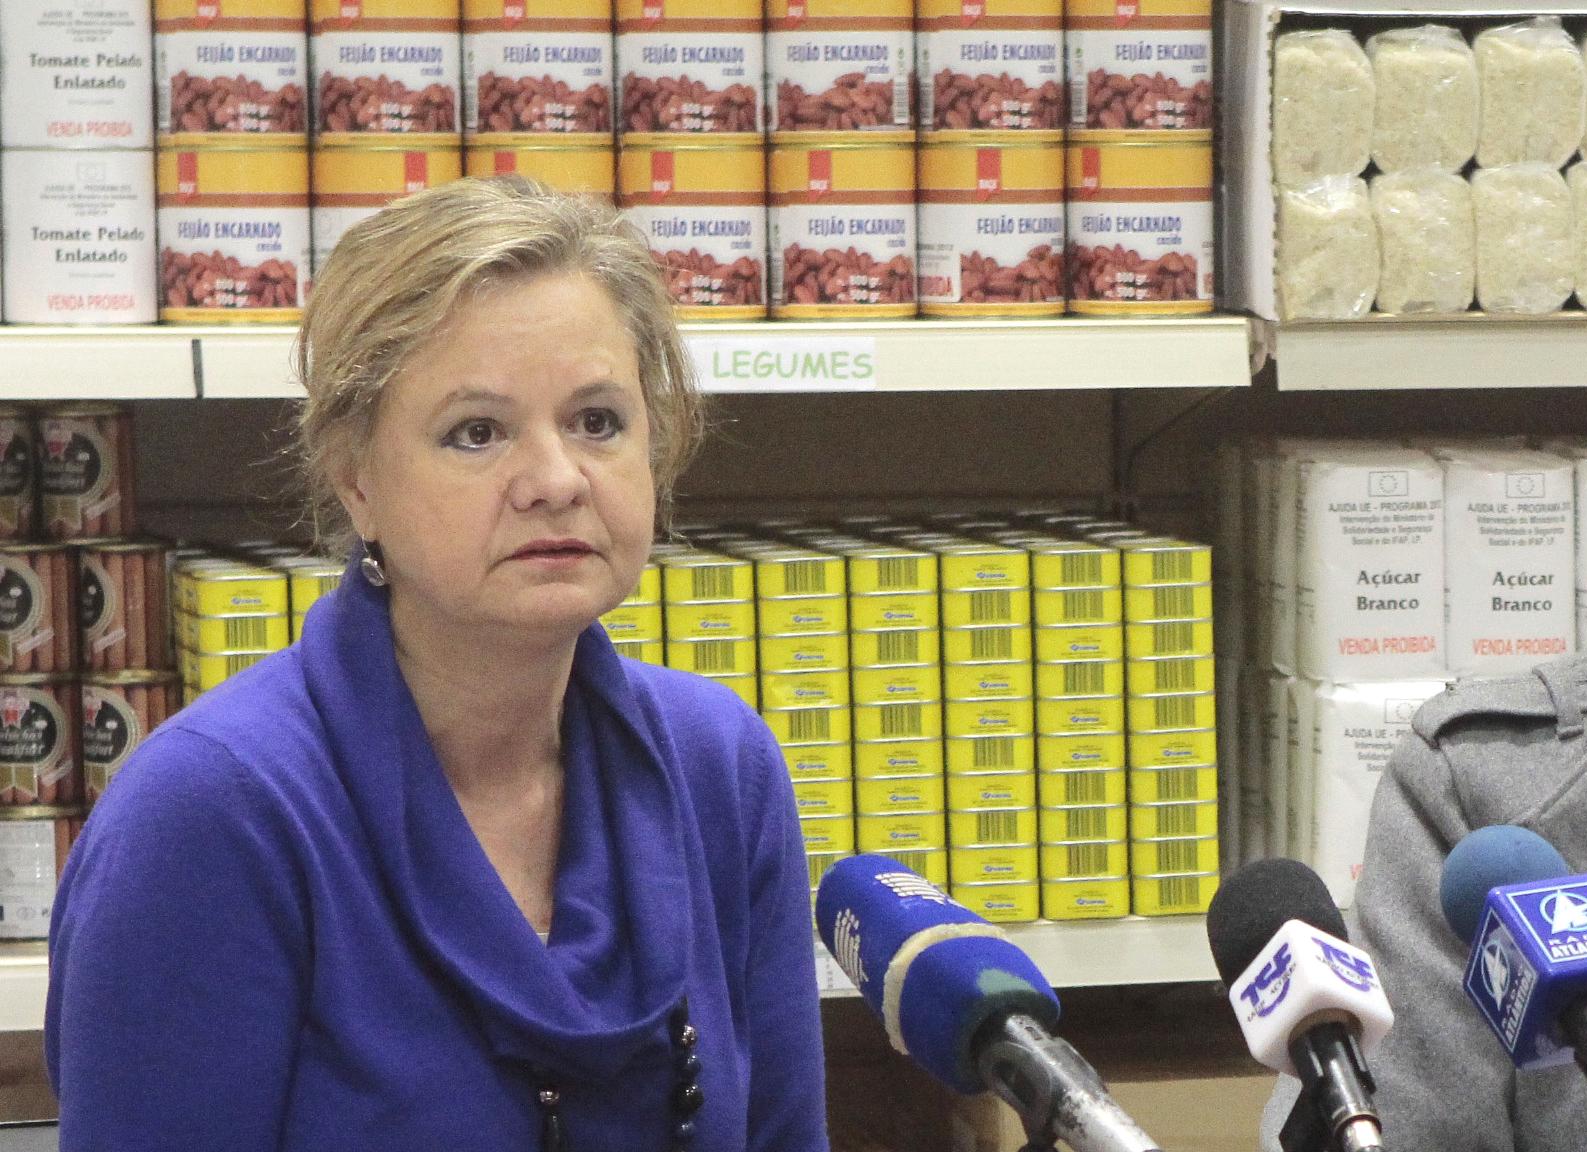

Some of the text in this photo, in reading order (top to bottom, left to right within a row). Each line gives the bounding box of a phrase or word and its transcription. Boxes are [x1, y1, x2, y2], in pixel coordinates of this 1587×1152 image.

[30, 54, 142, 68] Tomate Pelado
[197, 42, 234, 62] FEIJÃO
[340, 42, 376, 62] FEIJÃO
[503, 42, 540, 62] FEIJÃO
[642, 42, 677, 63] FEIJÃO
[787, 41, 820, 62] FEIJÃO
[961, 41, 998, 61] FEIJÃO
[1116, 41, 1152, 61] FEIJÃO
[54, 76, 125, 90] Enlatado
[32, 227, 144, 240] Tomate Pelado
[178, 219, 282, 239] FEIJÃO ENCARNADO
[652, 216, 686, 237] FEIJÃO
[808, 216, 844, 237] FEIJÃO
[978, 214, 1014, 235] FEIJÃO
[1082, 214, 1182, 234] FEIJÃO ENCARNADO
[56, 249, 128, 262] Enlatado
[713, 350, 873, 379] LEGUMES
[1357, 570, 1421, 587] Açúcar
[1493, 572, 1554, 589] Açúcar
[1357, 596, 1419, 610] Branco
[1492, 597, 1552, 611] Branco
[1339, 636, 1436, 656] VENDA PROIBIDA
[1473, 638, 1566, 656] VENDA PROIBIDA
